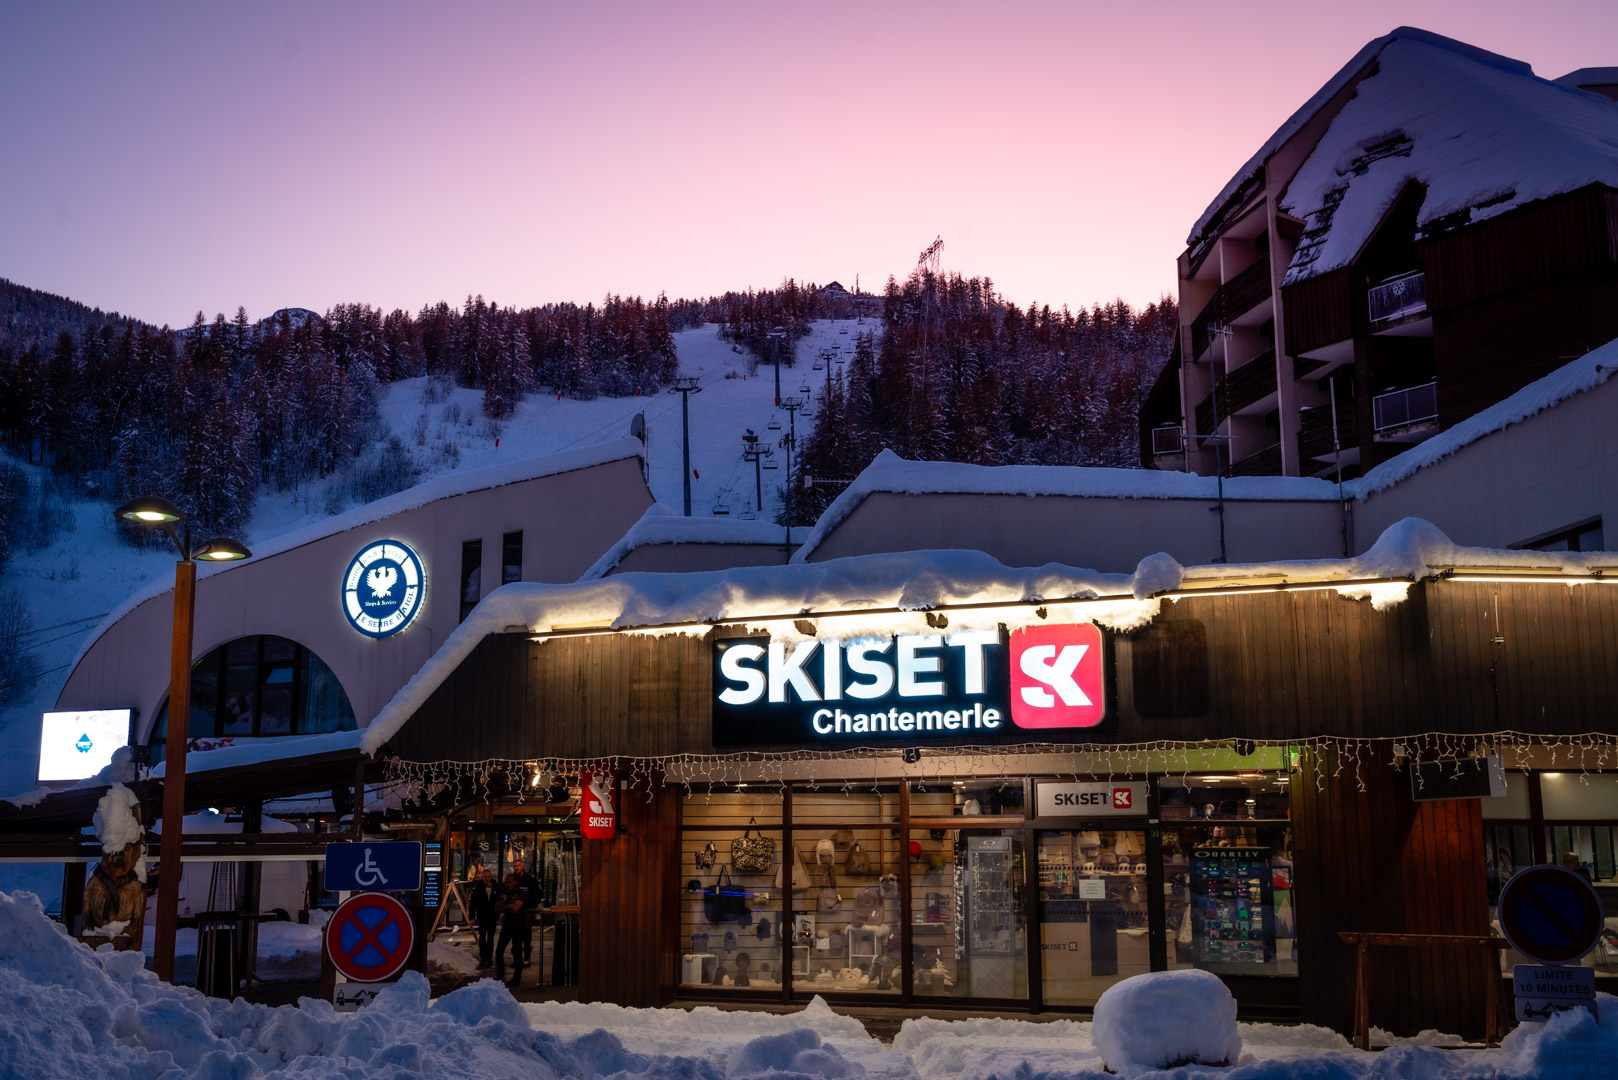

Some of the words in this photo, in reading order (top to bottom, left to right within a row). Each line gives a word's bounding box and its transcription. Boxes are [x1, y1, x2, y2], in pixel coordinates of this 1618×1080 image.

[368, 618, 394, 628] SERRE
[718, 632, 1000, 705] SKISET
[812, 703, 1001, 735] Chantemerle
[1054, 793, 1109, 805] SKISET
[589, 816, 613, 827] SKISET
[1041, 943, 1067, 951] SKISET
[1534, 969, 1574, 980] LIMITÉ
[1520, 983, 1533, 993] 10
[1537, 984, 1591, 994] MINUTES
